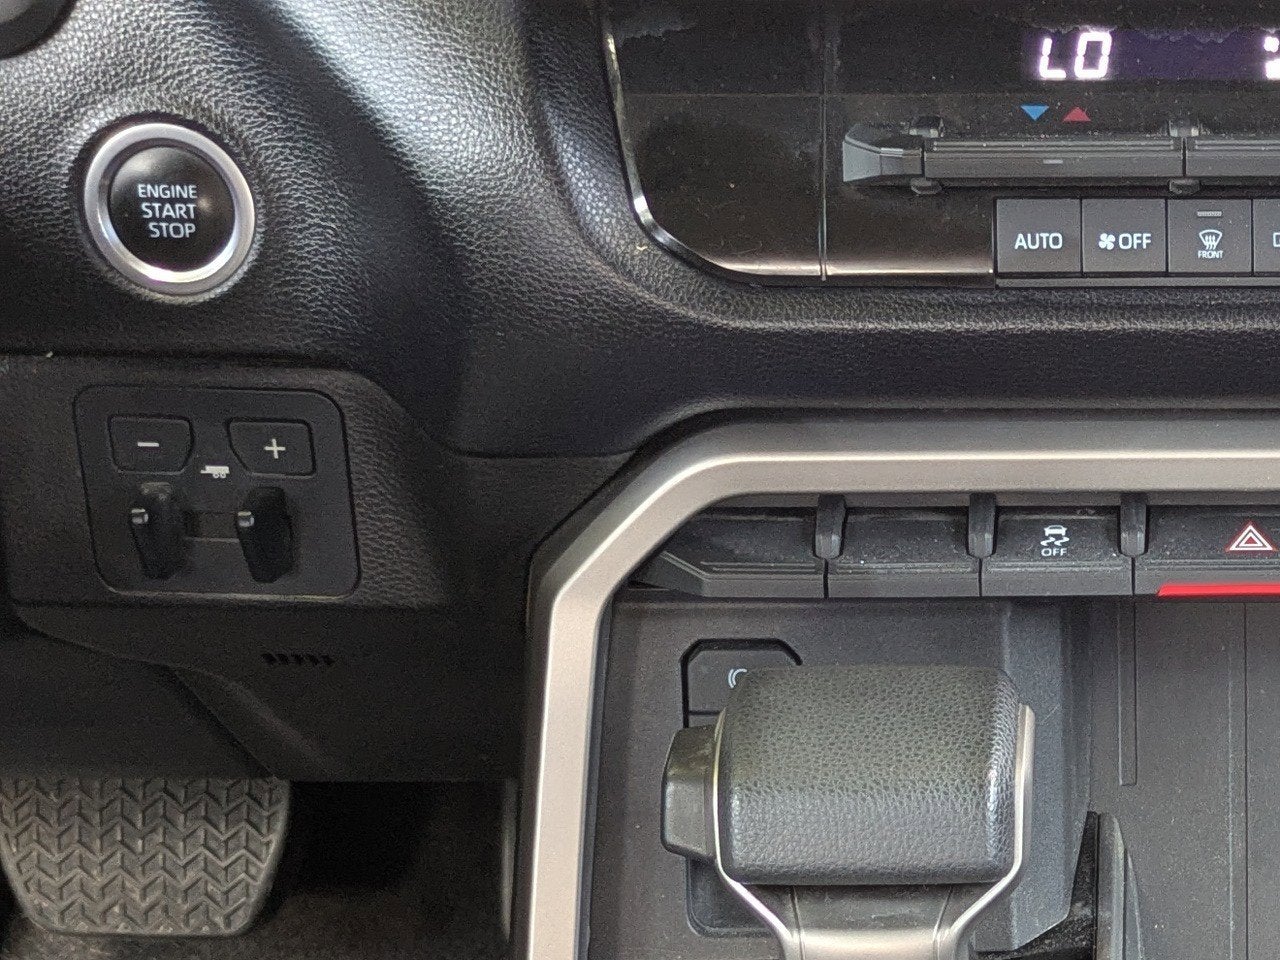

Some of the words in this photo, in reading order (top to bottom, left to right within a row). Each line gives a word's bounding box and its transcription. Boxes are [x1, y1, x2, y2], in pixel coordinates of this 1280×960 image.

[1037, 30, 1112, 80] LO
[137, 183, 198, 199] ENGINE
[141, 201, 197, 219] START
[148, 221, 196, 239] STOP
[1014, 232, 1063, 250] AUTO
[1118, 232, 1152, 250] OFF
[1197, 249, 1224, 259] FRONT
[1040, 547, 1067, 557] OFF
